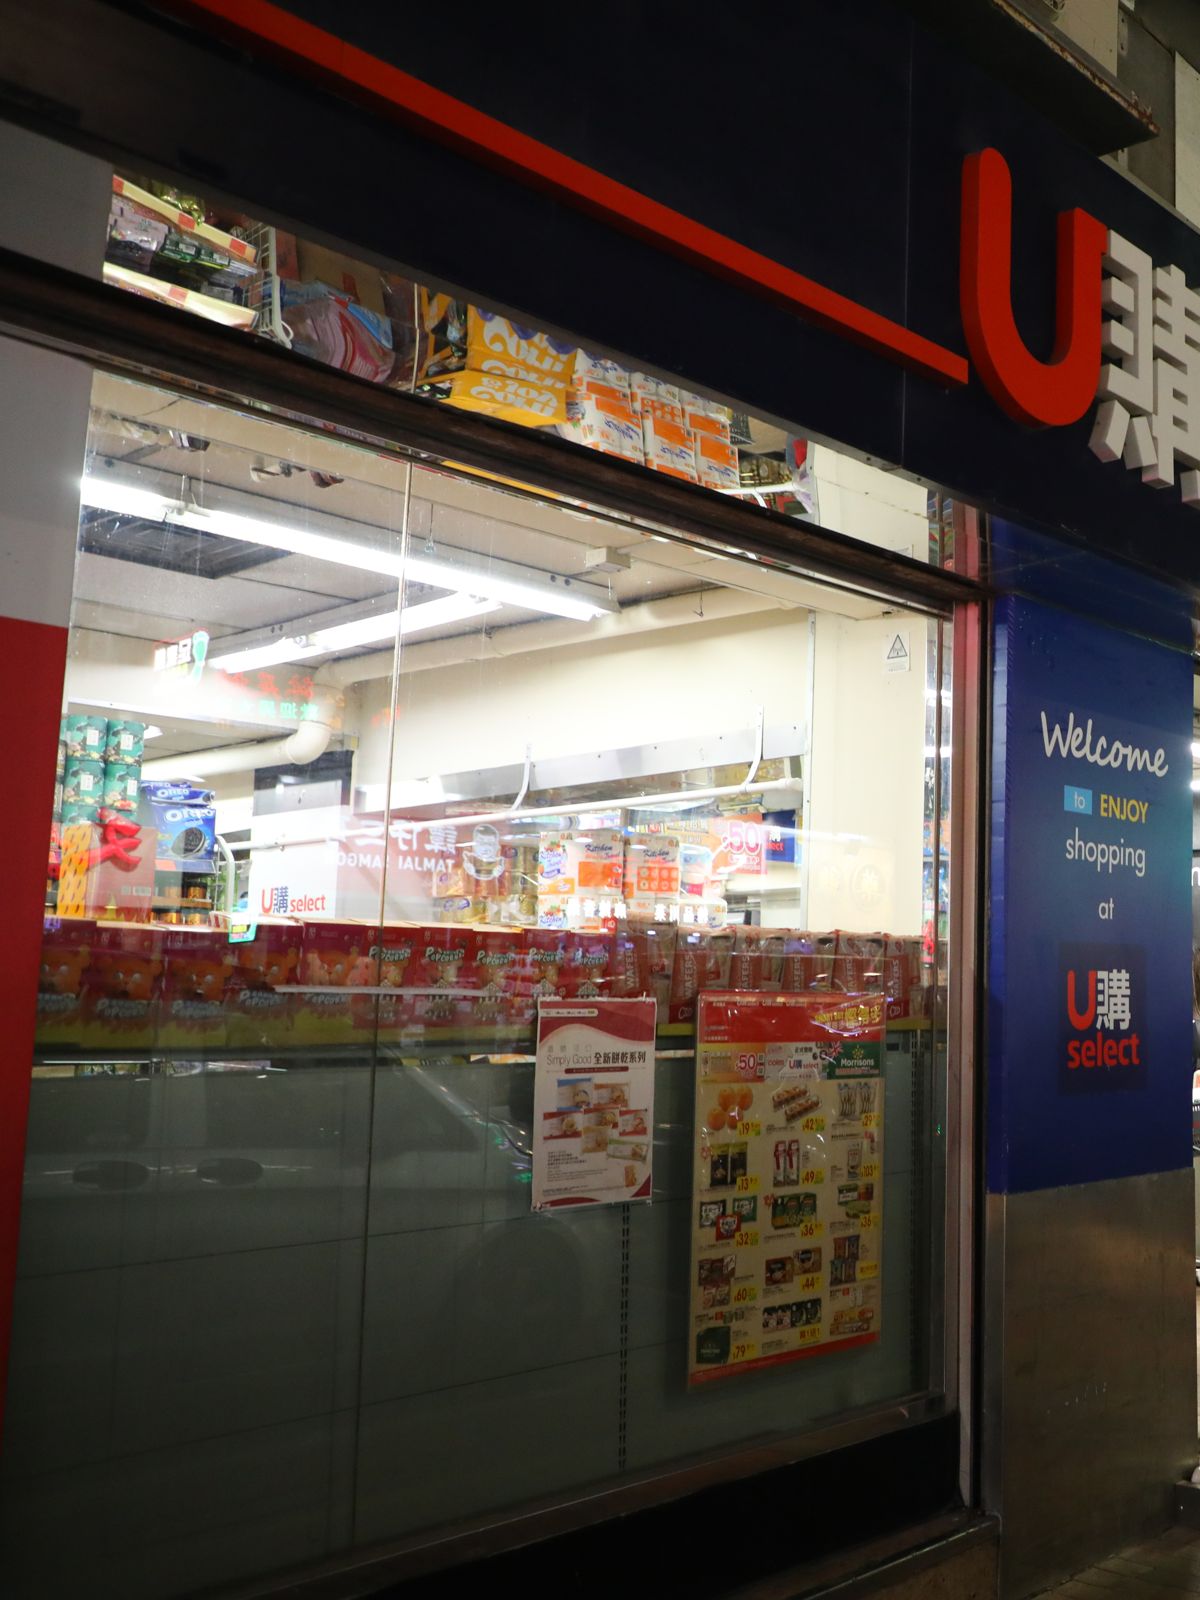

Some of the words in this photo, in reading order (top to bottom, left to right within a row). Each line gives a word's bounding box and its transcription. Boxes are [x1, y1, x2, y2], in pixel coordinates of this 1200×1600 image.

[1041, 711, 1168, 777] Welcome
[1074, 791, 1086, 809] to
[1100, 793, 1148, 823] ENJOY
[1066, 827, 1146, 877] shopping
[262, 886, 288, 914] U購
[290, 895, 326, 913] select
[1098, 898, 1114, 920] at
[1067, 969, 1131, 1031] U購
[841, 1057, 874, 1067] Morrisons
[1067, 1031, 1140, 1069] select
